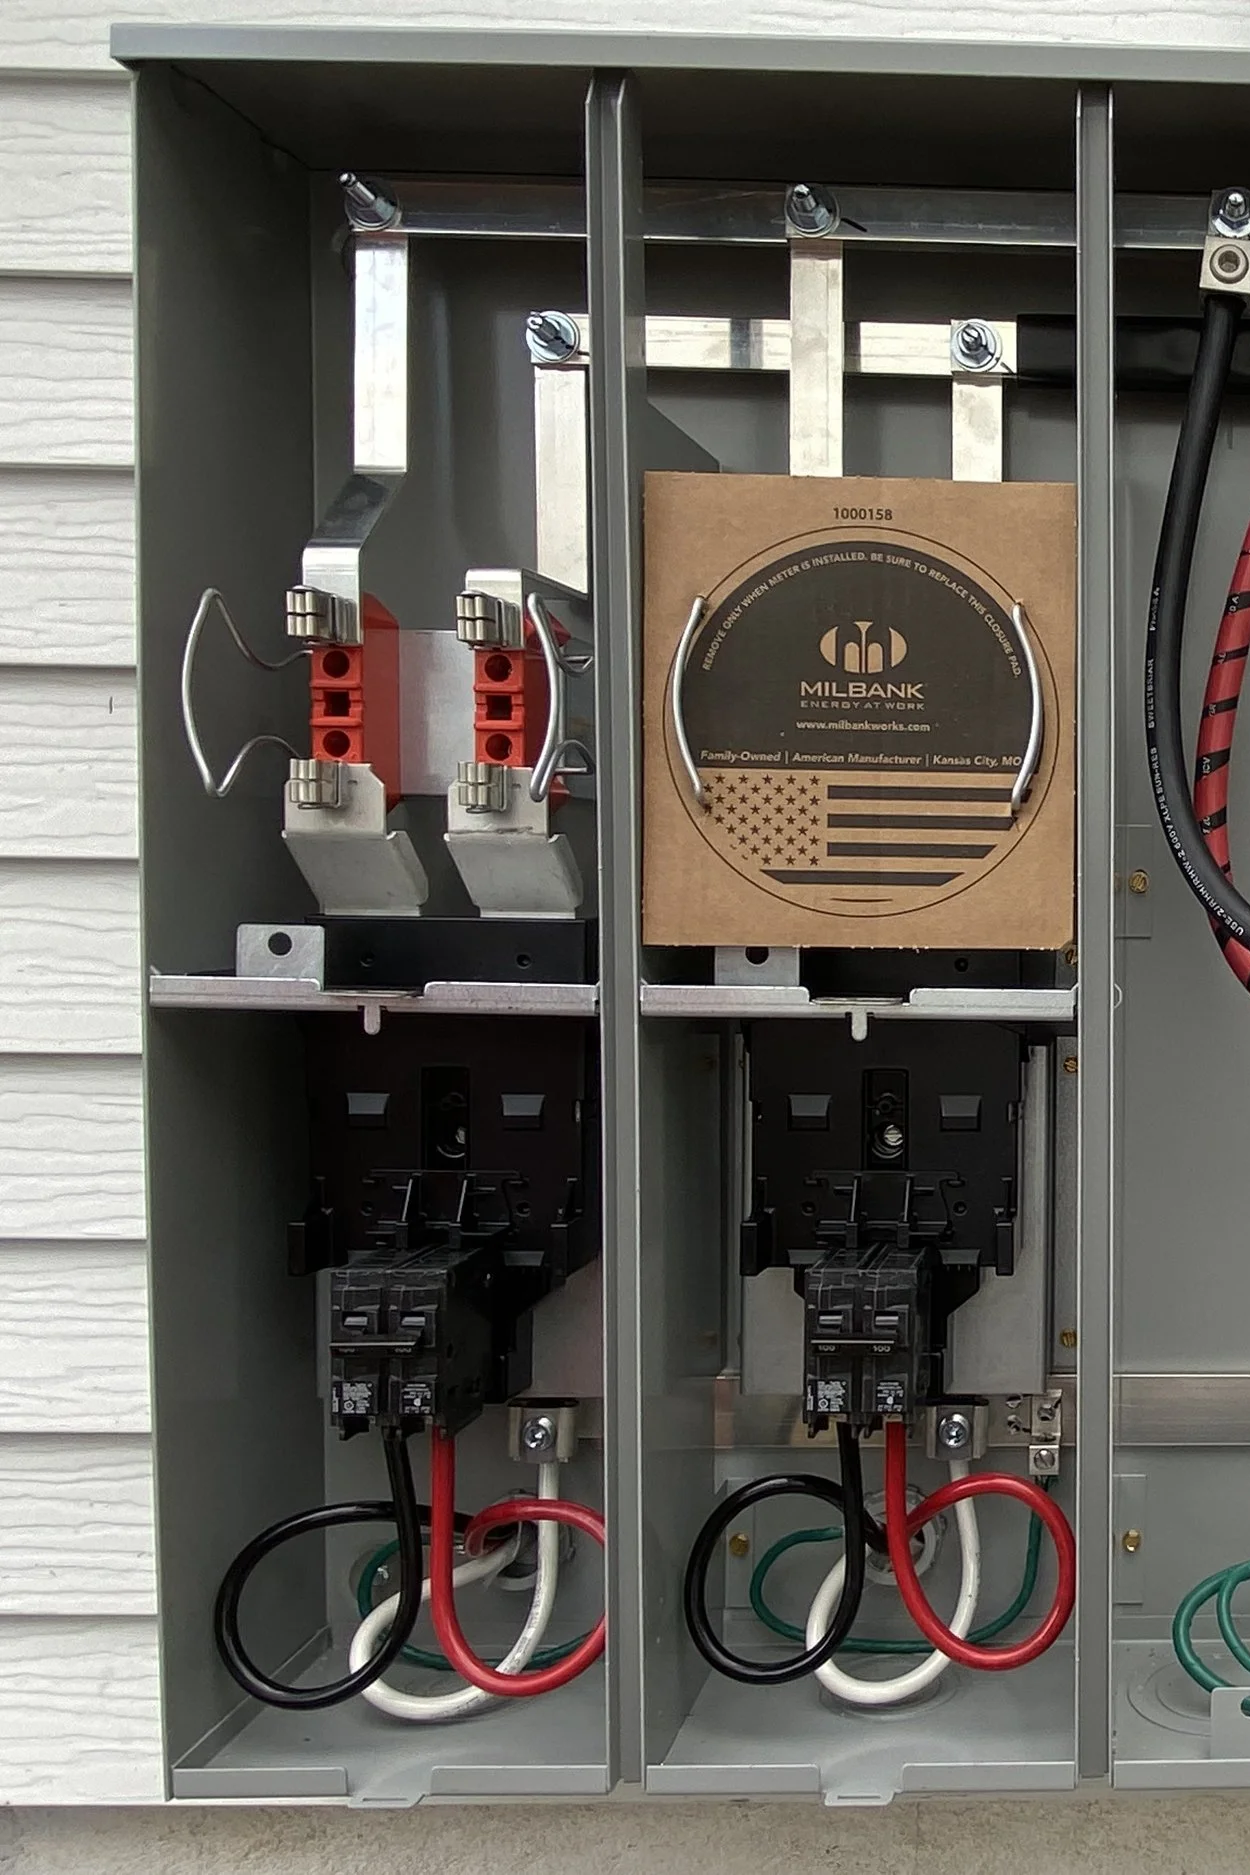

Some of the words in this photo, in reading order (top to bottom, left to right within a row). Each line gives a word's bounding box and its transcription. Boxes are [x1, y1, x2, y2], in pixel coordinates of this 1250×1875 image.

[833, 507, 893, 520] 1000158
[702, 630, 727, 670] REMOVE
[722, 606, 744, 630] ONLY
[742, 583, 769, 608] WHEN
[768, 566, 800, 586] METER
[801, 561, 812, 570] IS
[812, 552, 867, 567] INSTALLED.
[871, 552, 884, 562] BE
[886, 554, 912, 568] SURE
[914, 562, 928, 574] TO
[928, 569, 968, 598] REPLACE
[968, 594, 986, 615] THIS
[984, 614, 1013, 654] CLOSURE
[1008, 653, 1022, 678] PAD.
[801, 681, 924, 699] MILBANK
[801, 700, 860, 709] ENERGY
[864, 702, 880, 710] AT
[885, 702, 924, 710] WORK
[796, 720, 930, 732] www.milbankworks.com
[700, 750, 780, 763] Family-Owned
[792, 752, 844, 762] American
[848, 753, 922, 764] Manufacturer
[933, 755, 970, 765] Kansas
[974, 756, 998, 768] City,
[1002, 756, 1022, 766] MO
[1150, 747, 1163, 794] SUN-RES
[1158, 795, 1172, 822] XLPE
[1166, 824, 1182, 850] 600V
